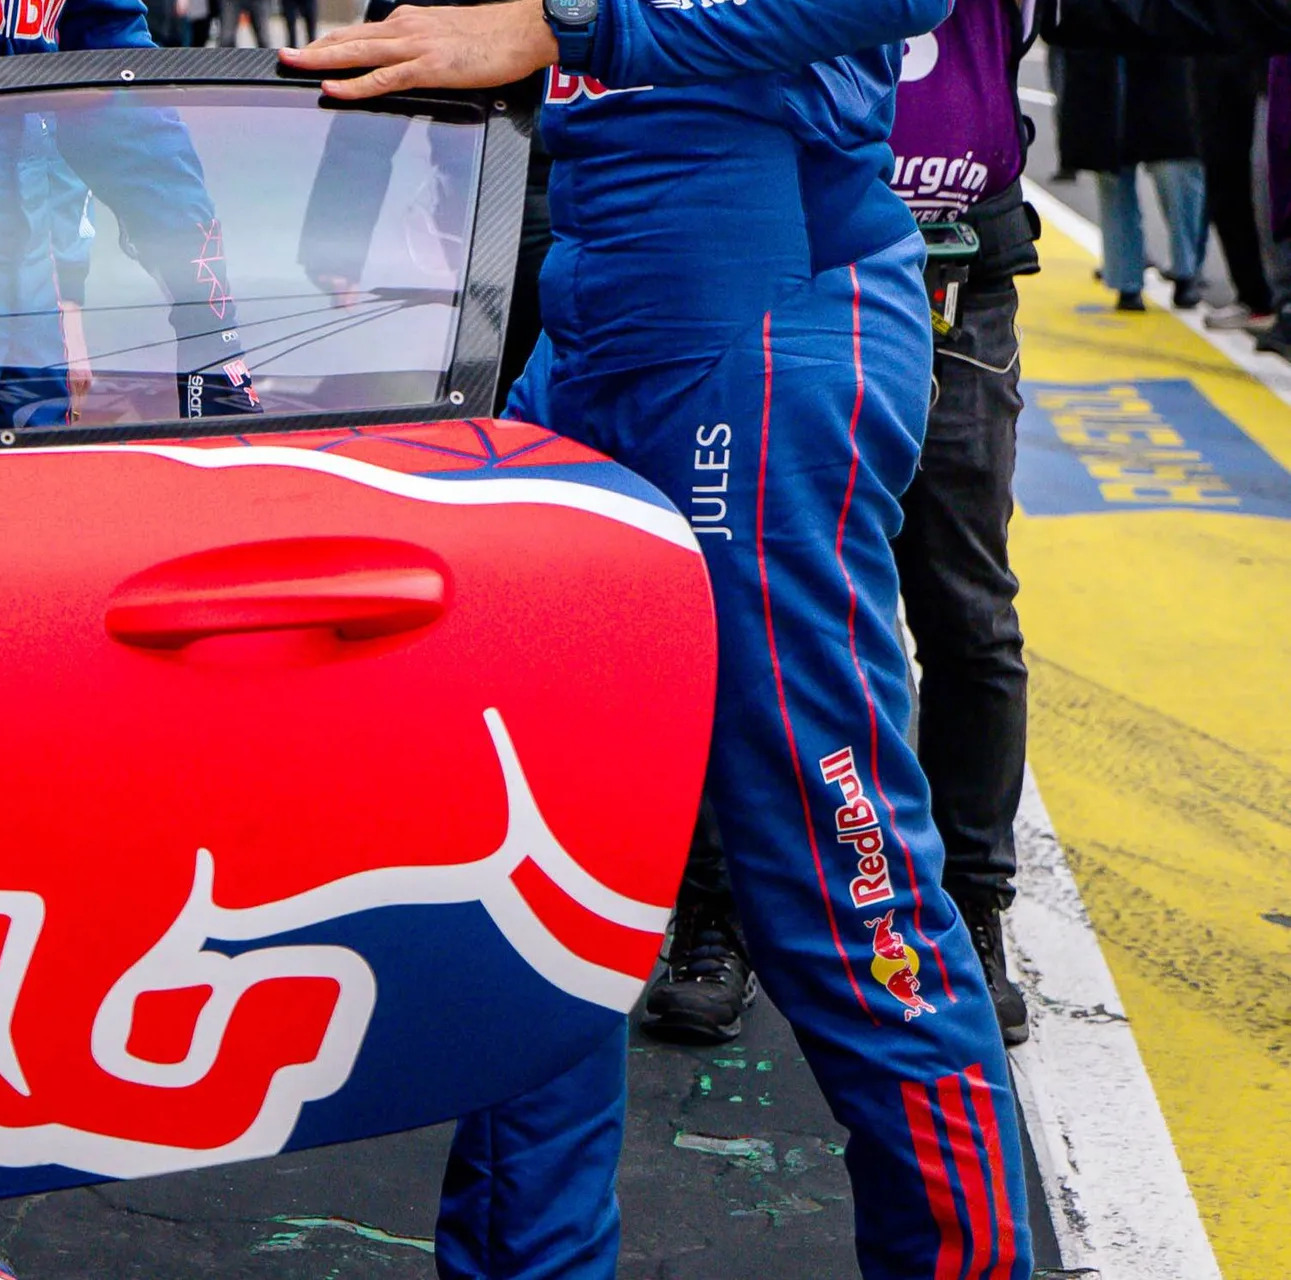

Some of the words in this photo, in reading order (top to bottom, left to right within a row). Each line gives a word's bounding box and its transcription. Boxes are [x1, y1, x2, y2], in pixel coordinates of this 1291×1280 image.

[187, 375, 204, 420] spar
[691, 423, 733, 541] JULES
[819, 746, 880, 833] Bull
[836, 825, 895, 908] Red
